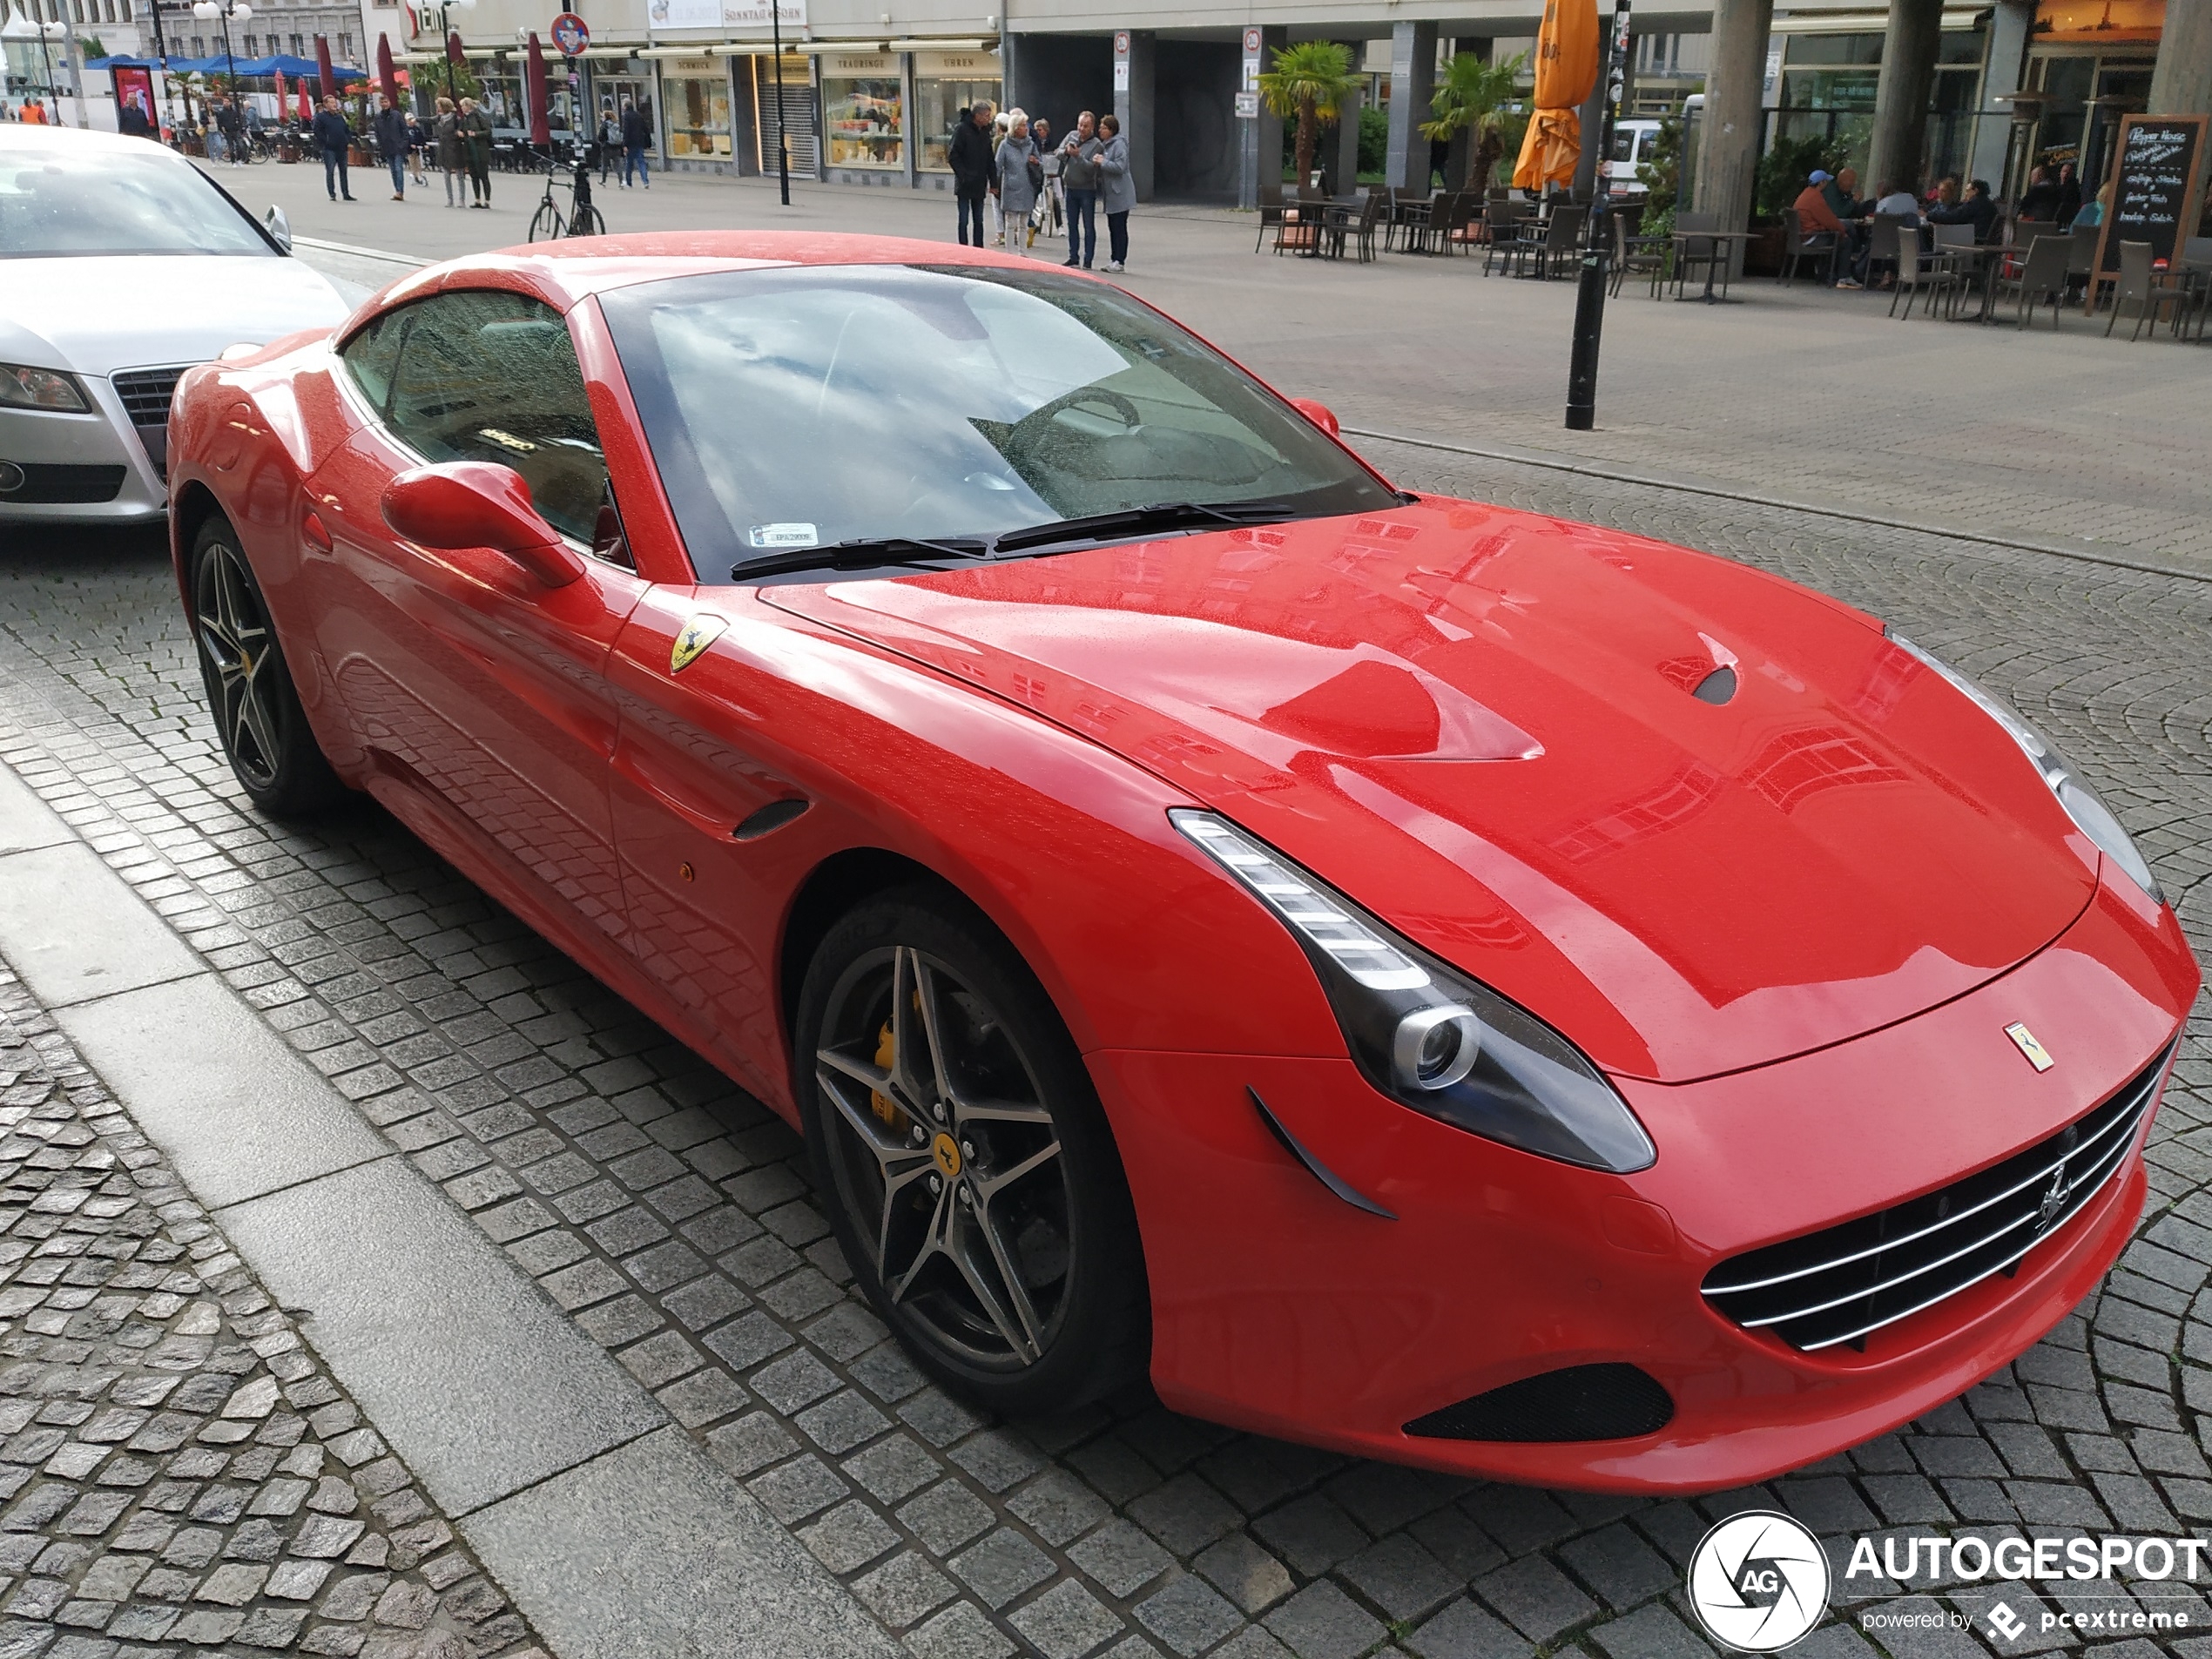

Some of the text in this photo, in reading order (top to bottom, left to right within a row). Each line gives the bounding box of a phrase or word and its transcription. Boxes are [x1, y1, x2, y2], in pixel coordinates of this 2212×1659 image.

[724, 9, 766, 21] SONNTAG
[776, 6, 800, 18] SOHN
[838, 59, 885, 69] TRAURINGE
[943, 57, 974, 67] UHREN
